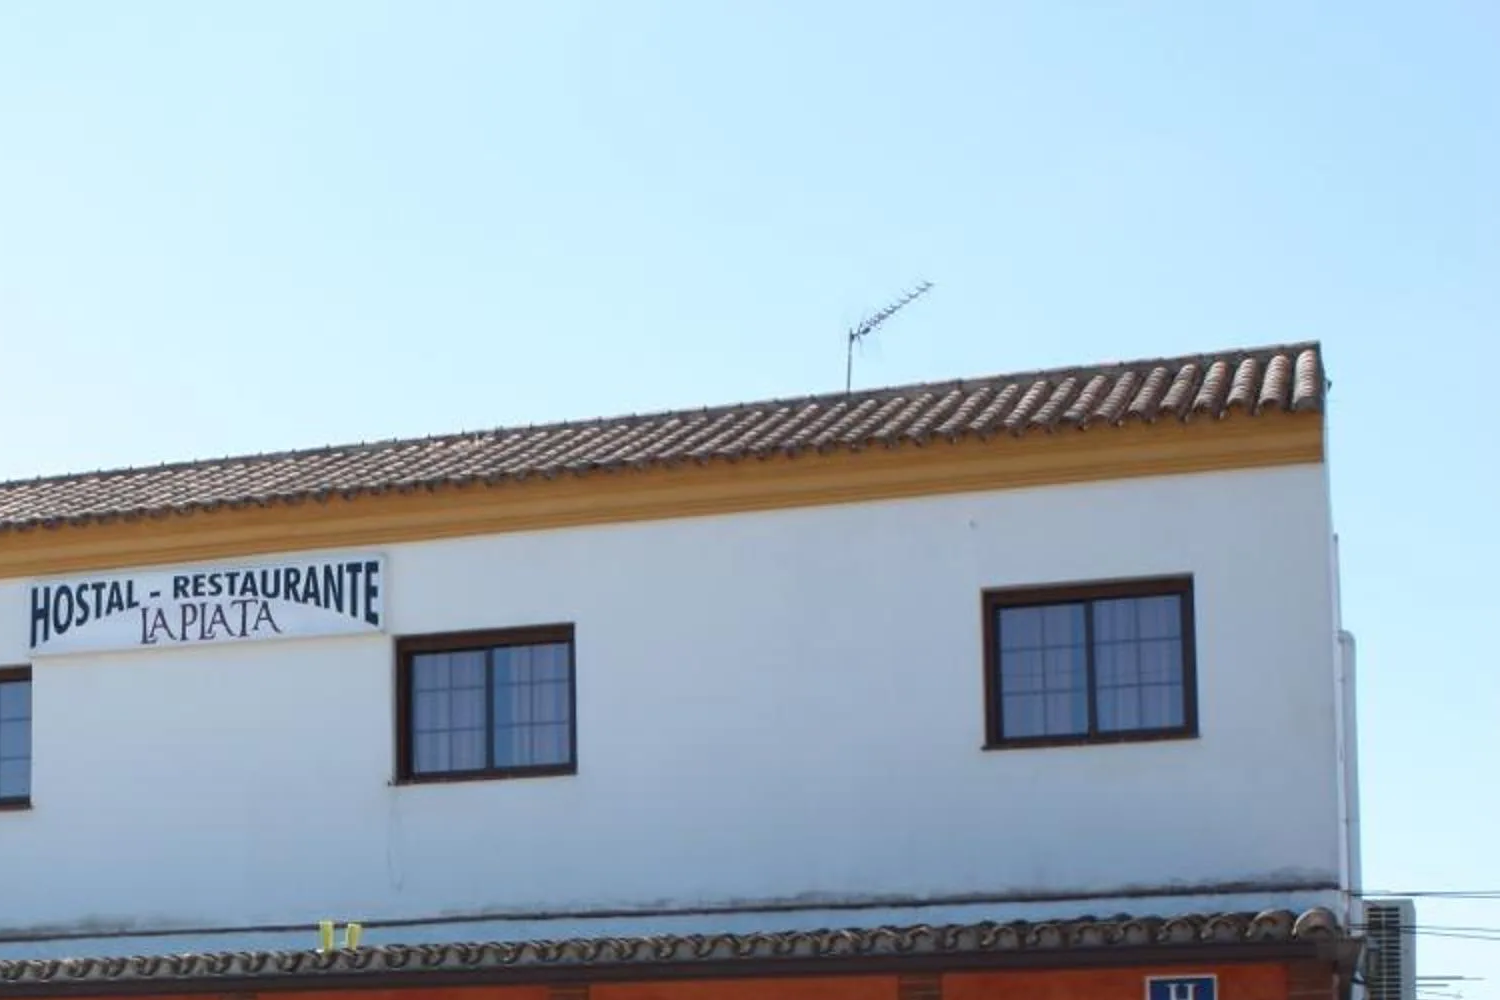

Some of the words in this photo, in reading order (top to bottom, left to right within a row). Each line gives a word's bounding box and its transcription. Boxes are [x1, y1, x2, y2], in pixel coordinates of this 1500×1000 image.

[30, 579, 139, 648] HOSTAL
[173, 560, 380, 627] RESTAURANTE
[140, 605, 177, 645] LA
[179, 598, 283, 642] PLATA
